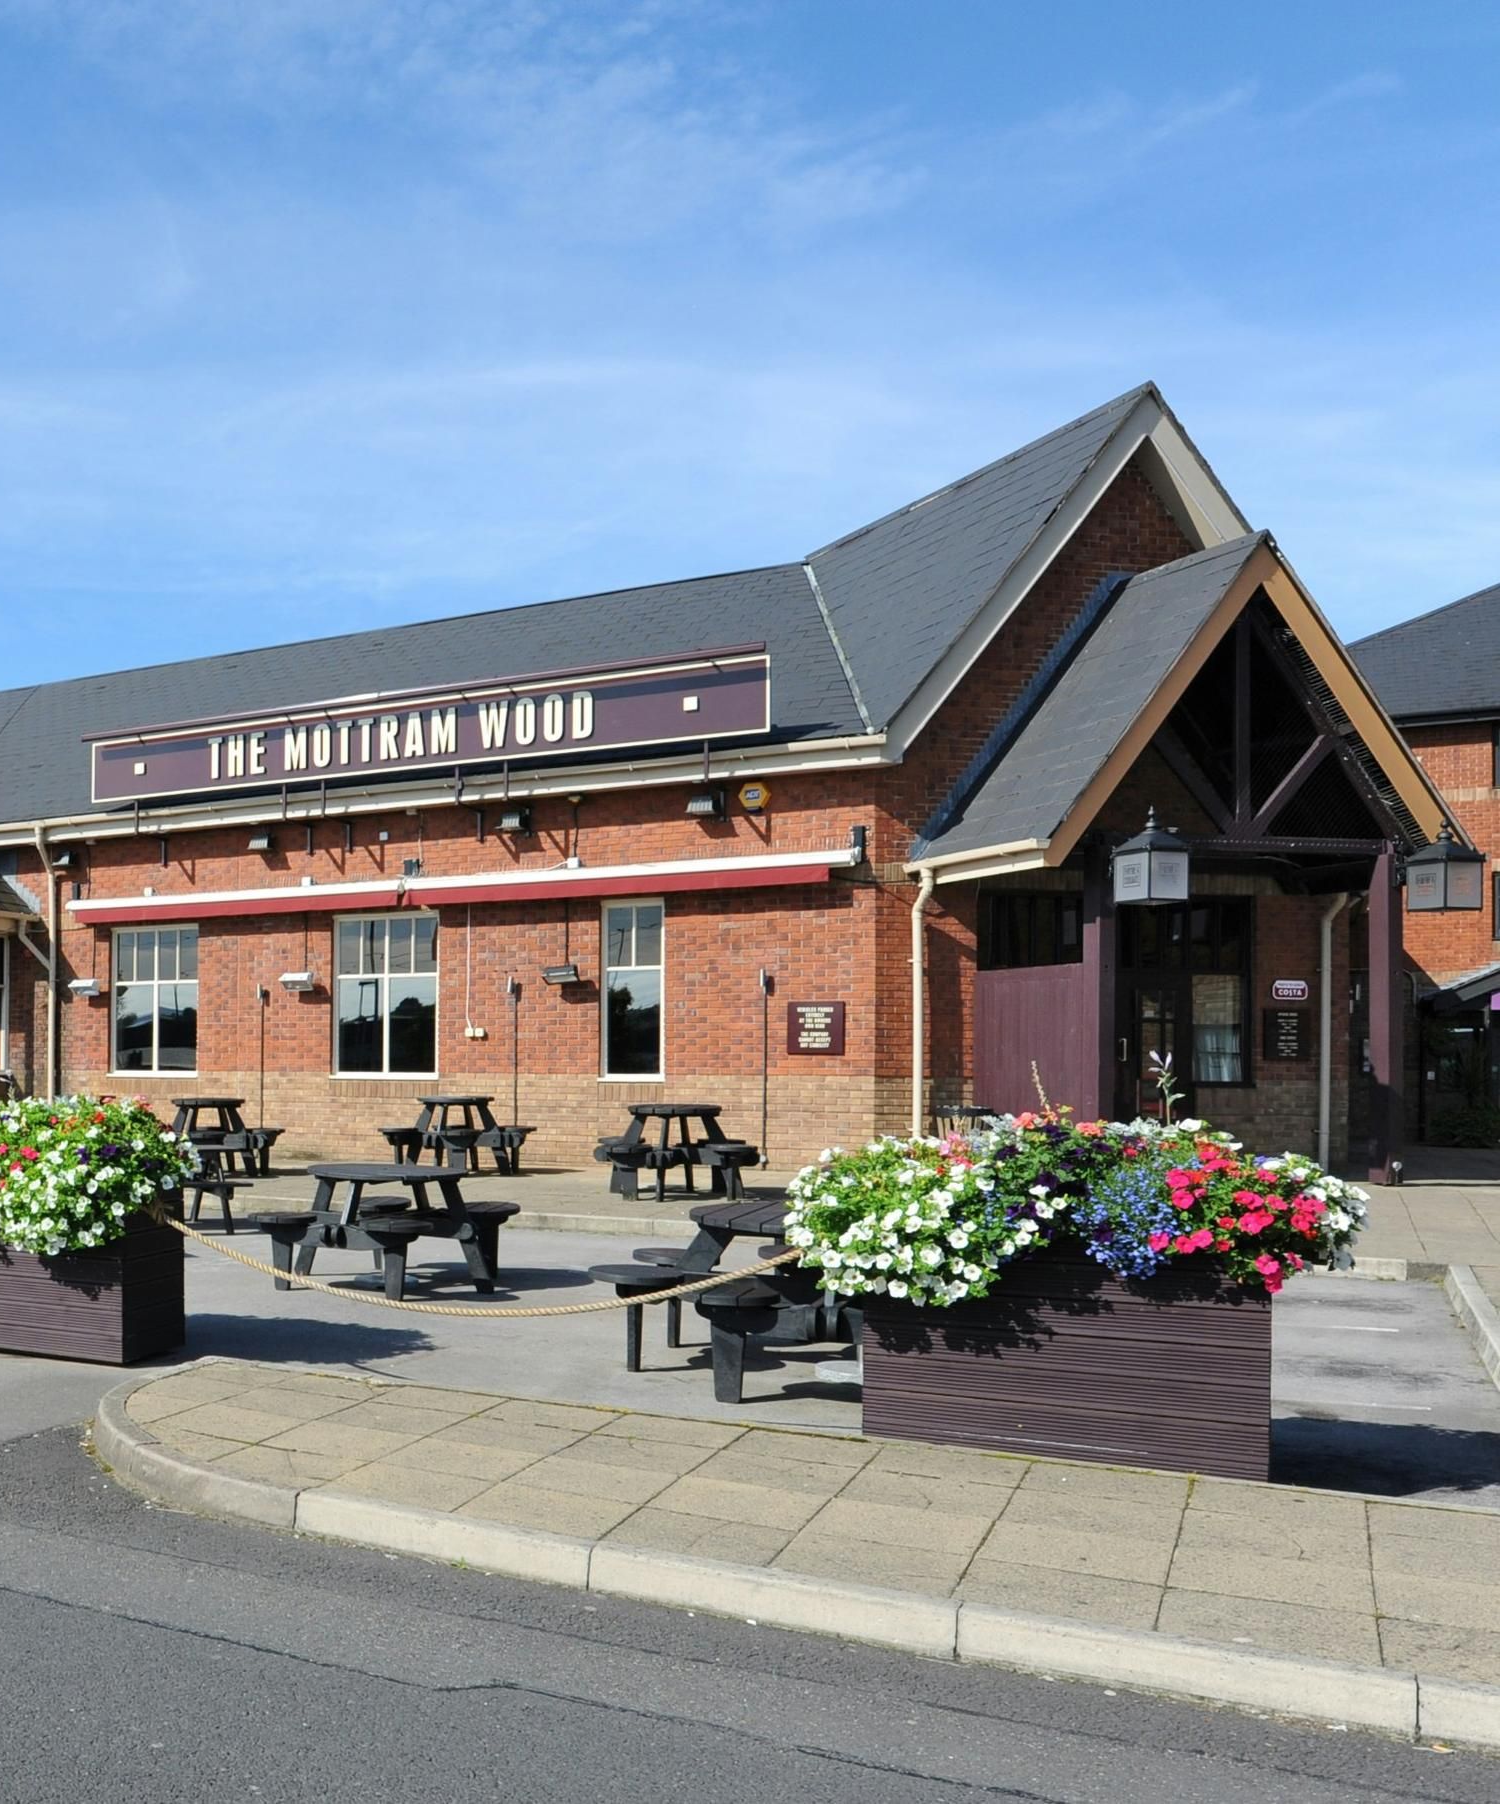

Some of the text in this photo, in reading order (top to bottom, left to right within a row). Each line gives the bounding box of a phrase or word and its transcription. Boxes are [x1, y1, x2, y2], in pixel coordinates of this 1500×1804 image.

[207, 690, 594, 780] THE MOTTRAM WOOD
[1278, 989, 1302, 997] COSTA
